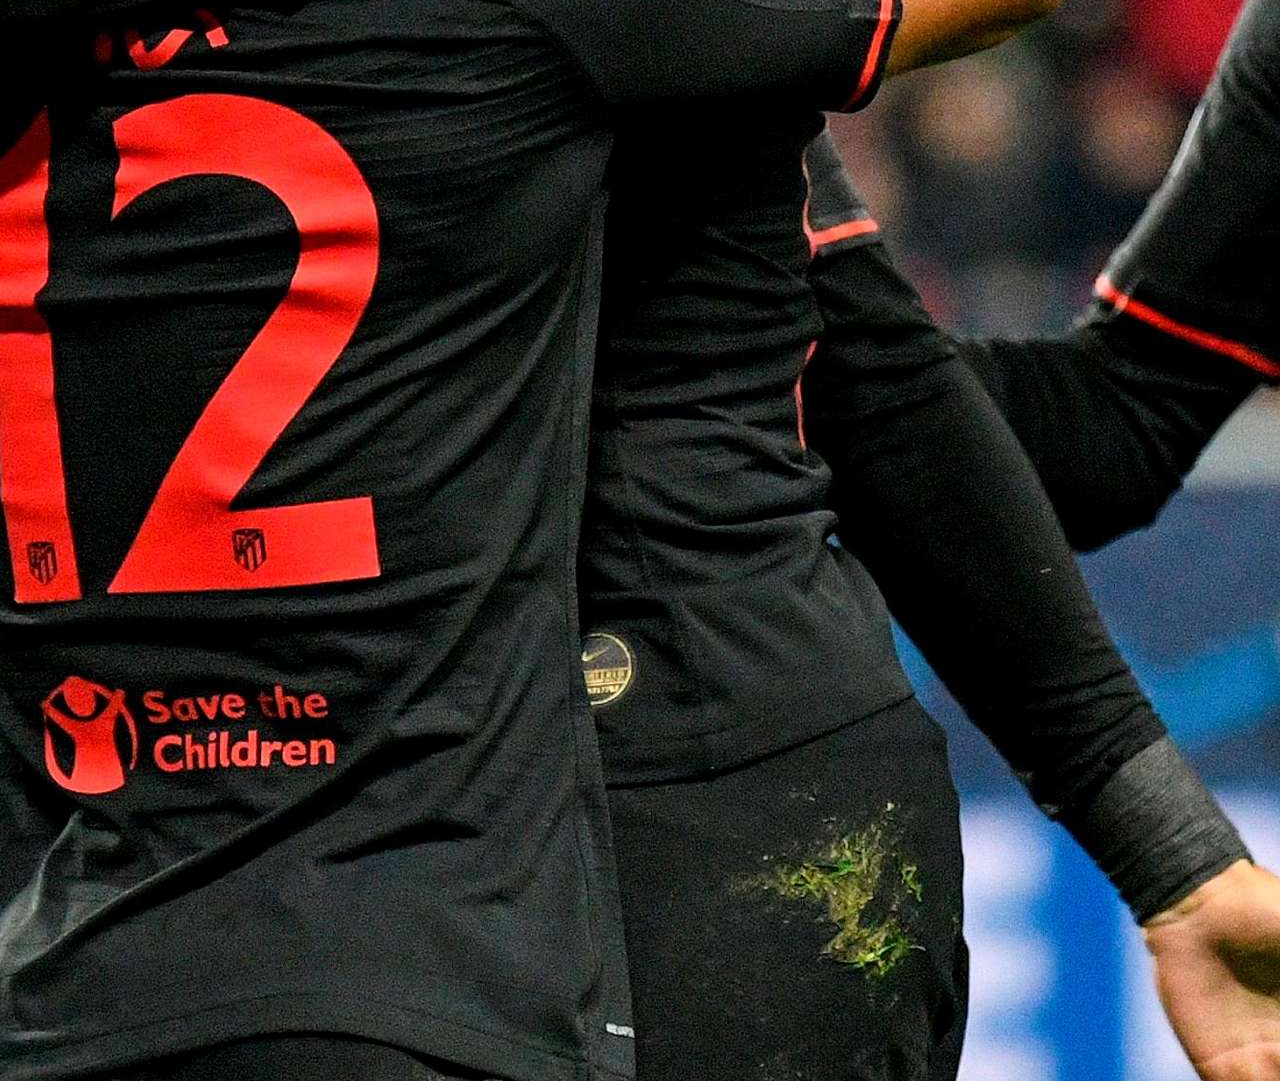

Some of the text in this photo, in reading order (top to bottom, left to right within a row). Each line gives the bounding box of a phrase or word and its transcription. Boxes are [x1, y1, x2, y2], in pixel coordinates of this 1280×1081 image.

[142, 683, 329, 724] Save the
[153, 729, 337, 772] Children
